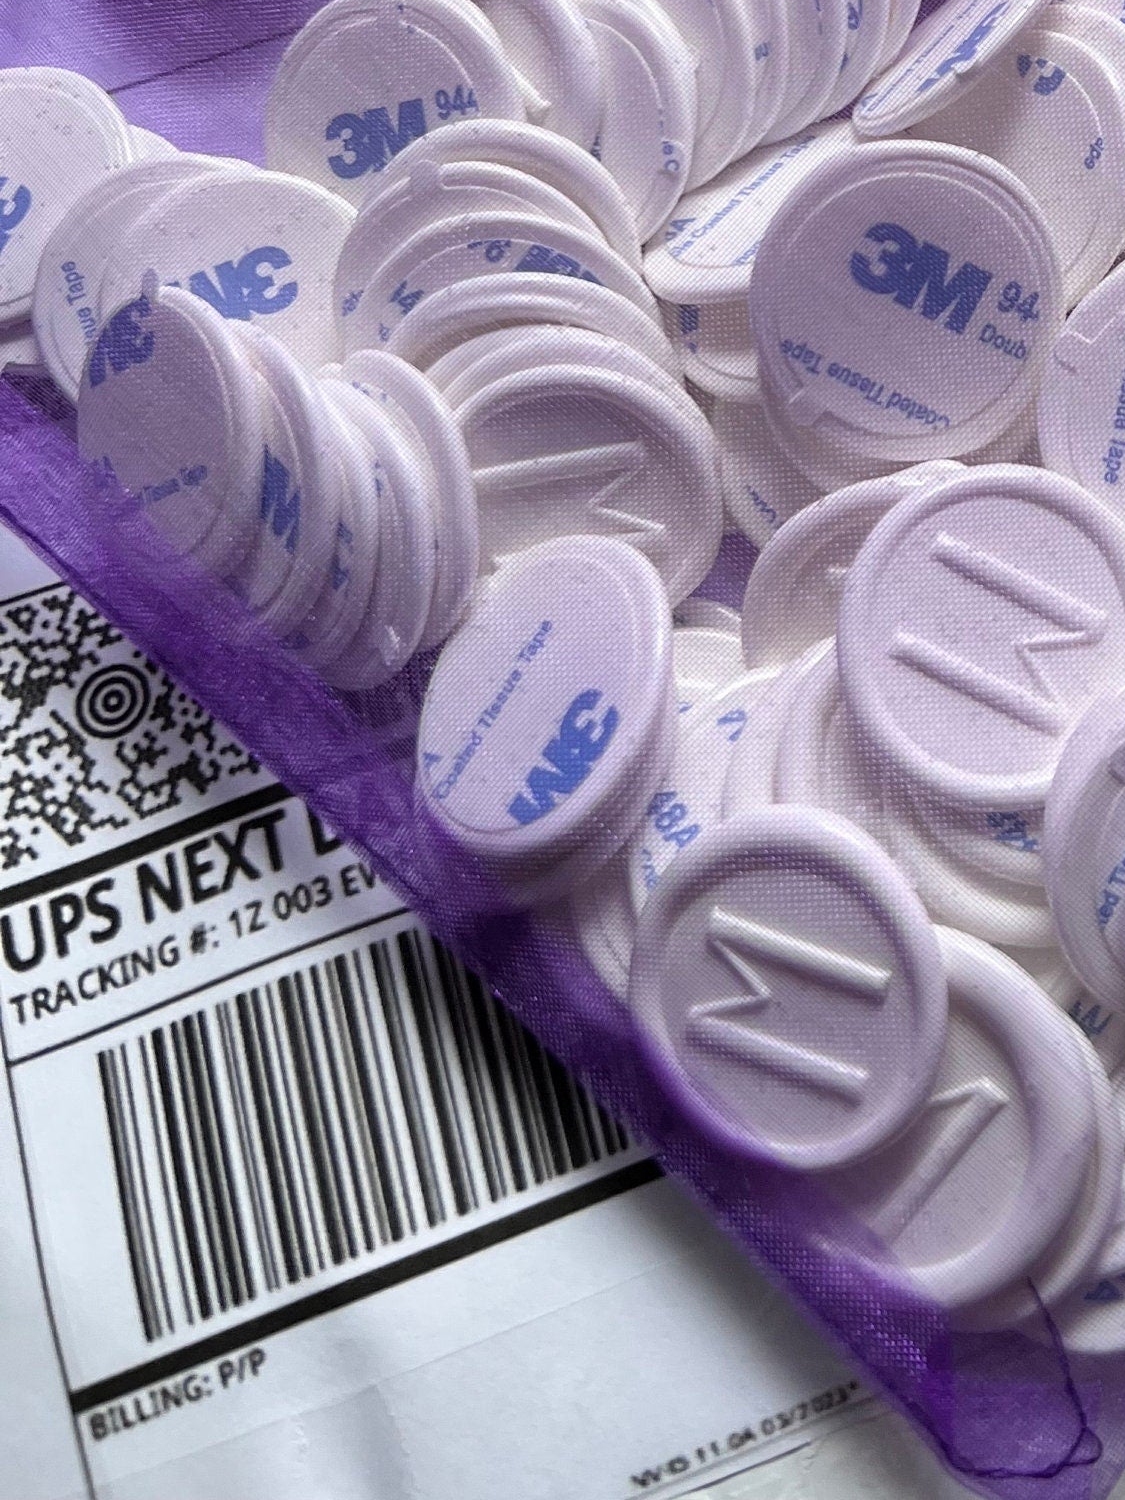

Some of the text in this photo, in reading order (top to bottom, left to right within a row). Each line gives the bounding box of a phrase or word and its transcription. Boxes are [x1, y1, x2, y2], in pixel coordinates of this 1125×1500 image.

[325, 97, 428, 180] 3M
[60, 260, 88, 307] Tape
[850, 221, 993, 335] 3M
[779, 338, 823, 375] Tape
[826, 361, 885, 406] Tissue
[477, 669, 522, 728] Tissue
[517, 620, 553, 663] Tape
[506, 688, 620, 826] 3M
[0, 877, 123, 974] UPS
[135, 808, 287, 925] NEXT
[9, 934, 182, 1025] TRACKING
[189, 921, 220, 954] #:
[228, 899, 266, 940] 1Z
[272, 877, 333, 922] 003
[88, 1347, 267, 1442] BILLING: P/P
